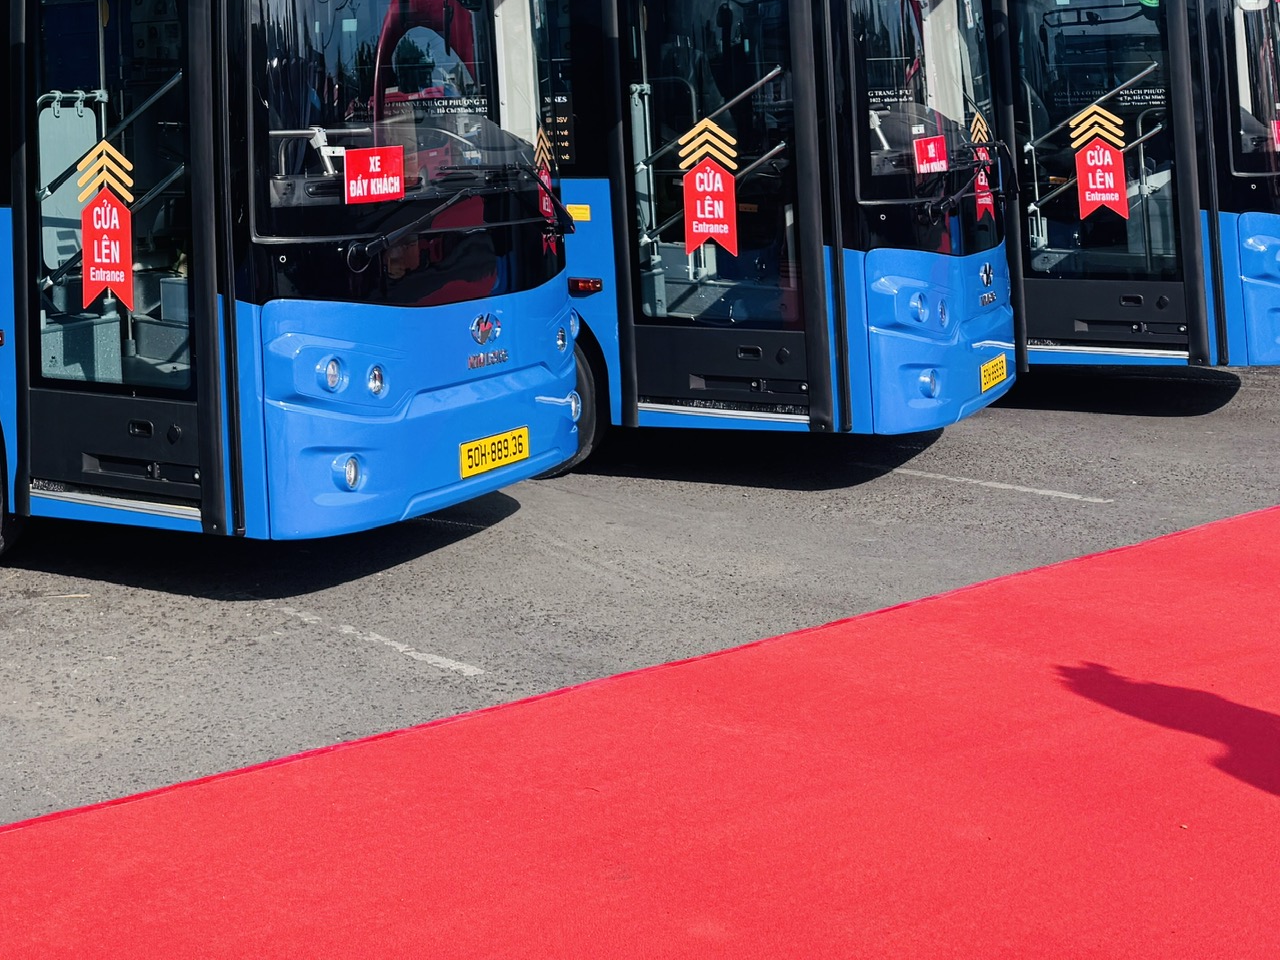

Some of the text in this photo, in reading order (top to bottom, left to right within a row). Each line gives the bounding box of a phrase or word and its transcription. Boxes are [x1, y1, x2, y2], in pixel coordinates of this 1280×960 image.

[369, 155, 381, 173] XE
[1086, 145, 1113, 166] CỬA
[370, 173, 400, 195] KHÁCH
[695, 166, 724, 192] CỬA
[1088, 168, 1114, 189] LÊN
[696, 195, 724, 219] LÊN
[1085, 191, 1120, 202] Entrance
[93, 199, 120, 229] CỬA
[692, 221, 729, 234] Entrance
[94, 234, 120, 263] LÊN
[90, 267, 125, 282] Entrance
[467, 434, 523, 469] 50H-889.36
